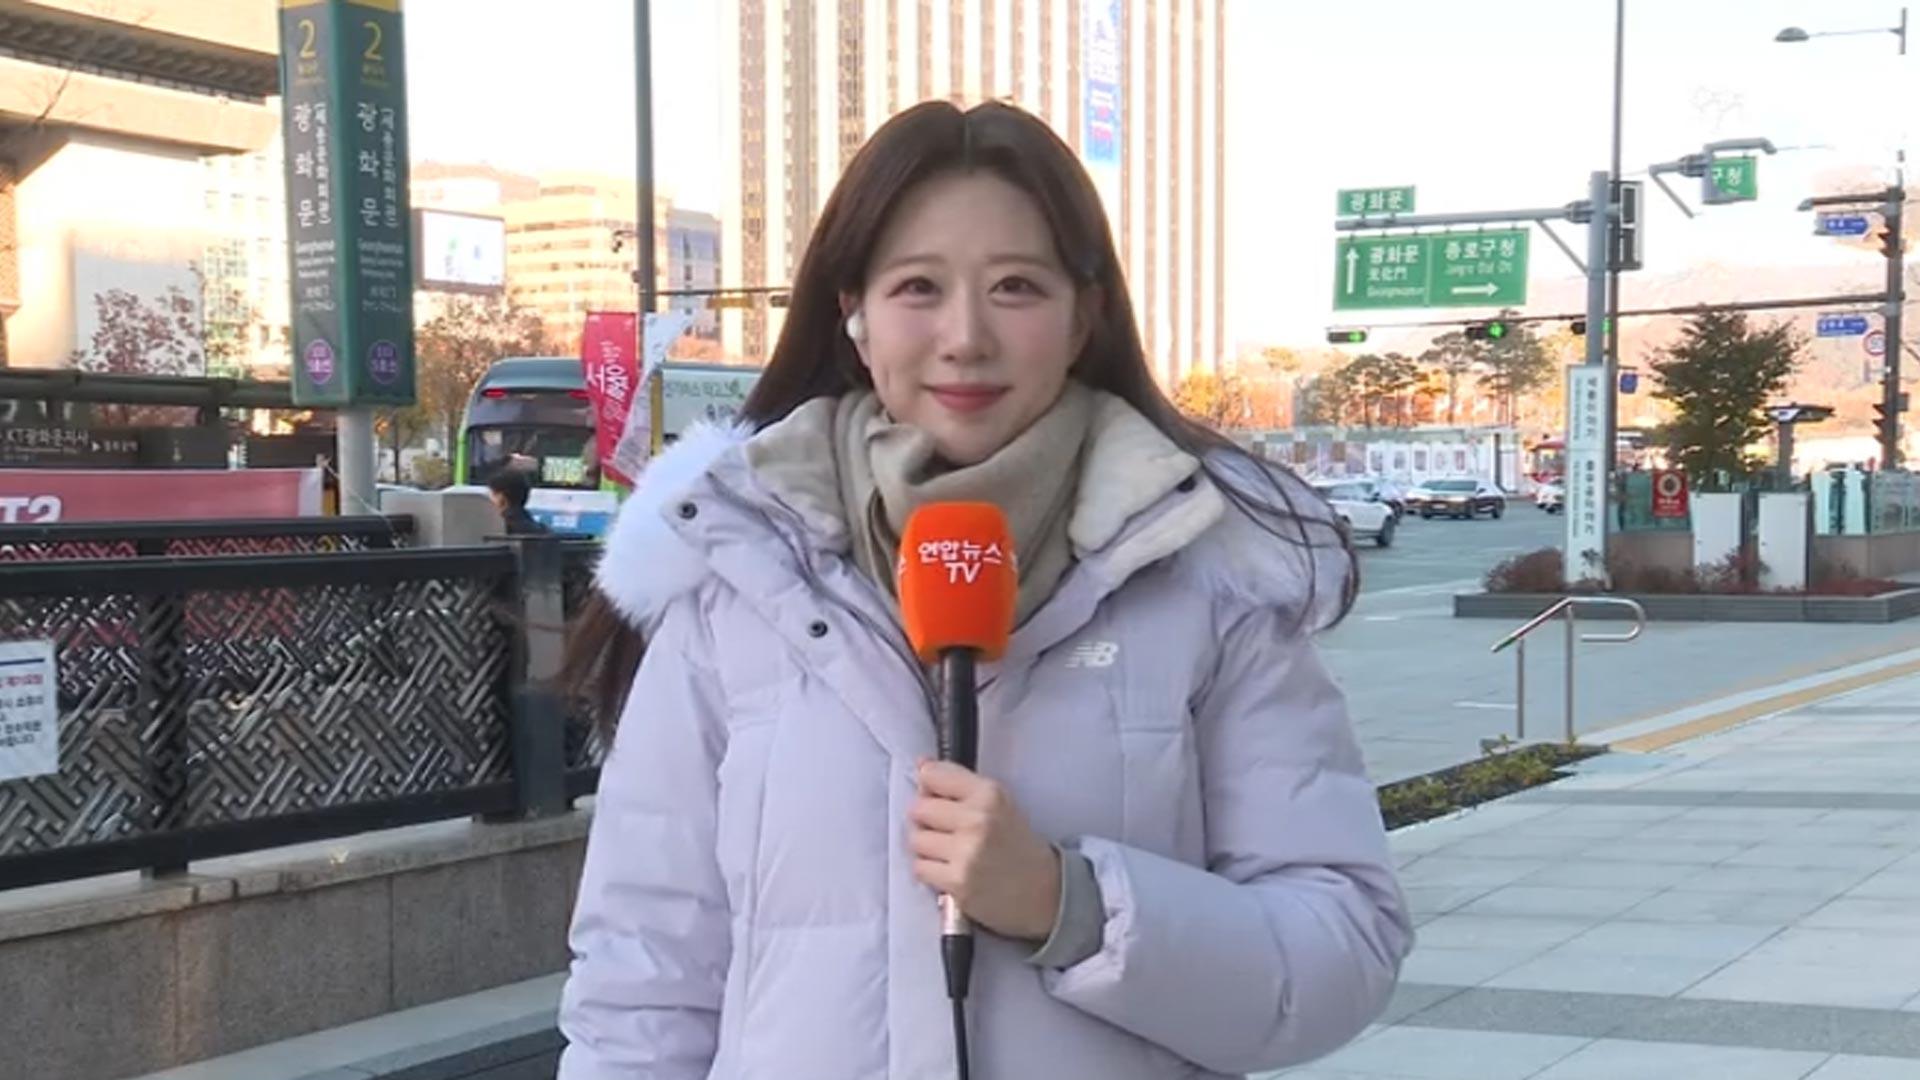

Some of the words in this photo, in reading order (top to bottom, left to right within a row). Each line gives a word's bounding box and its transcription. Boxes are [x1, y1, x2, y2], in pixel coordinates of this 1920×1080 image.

[299, 19, 316, 59] 2
[364, 21, 383, 60] 2
[294, 101, 315, 227] 광화문
[357, 101, 381, 227] 광화문
[1350, 191, 1403, 212] 광화문
[1369, 245, 1420, 264] 광화문
[1446, 238, 1517, 260] 종로구청
[918, 541, 1002, 564] 연합뉴스
[946, 562, 982, 584] TV
